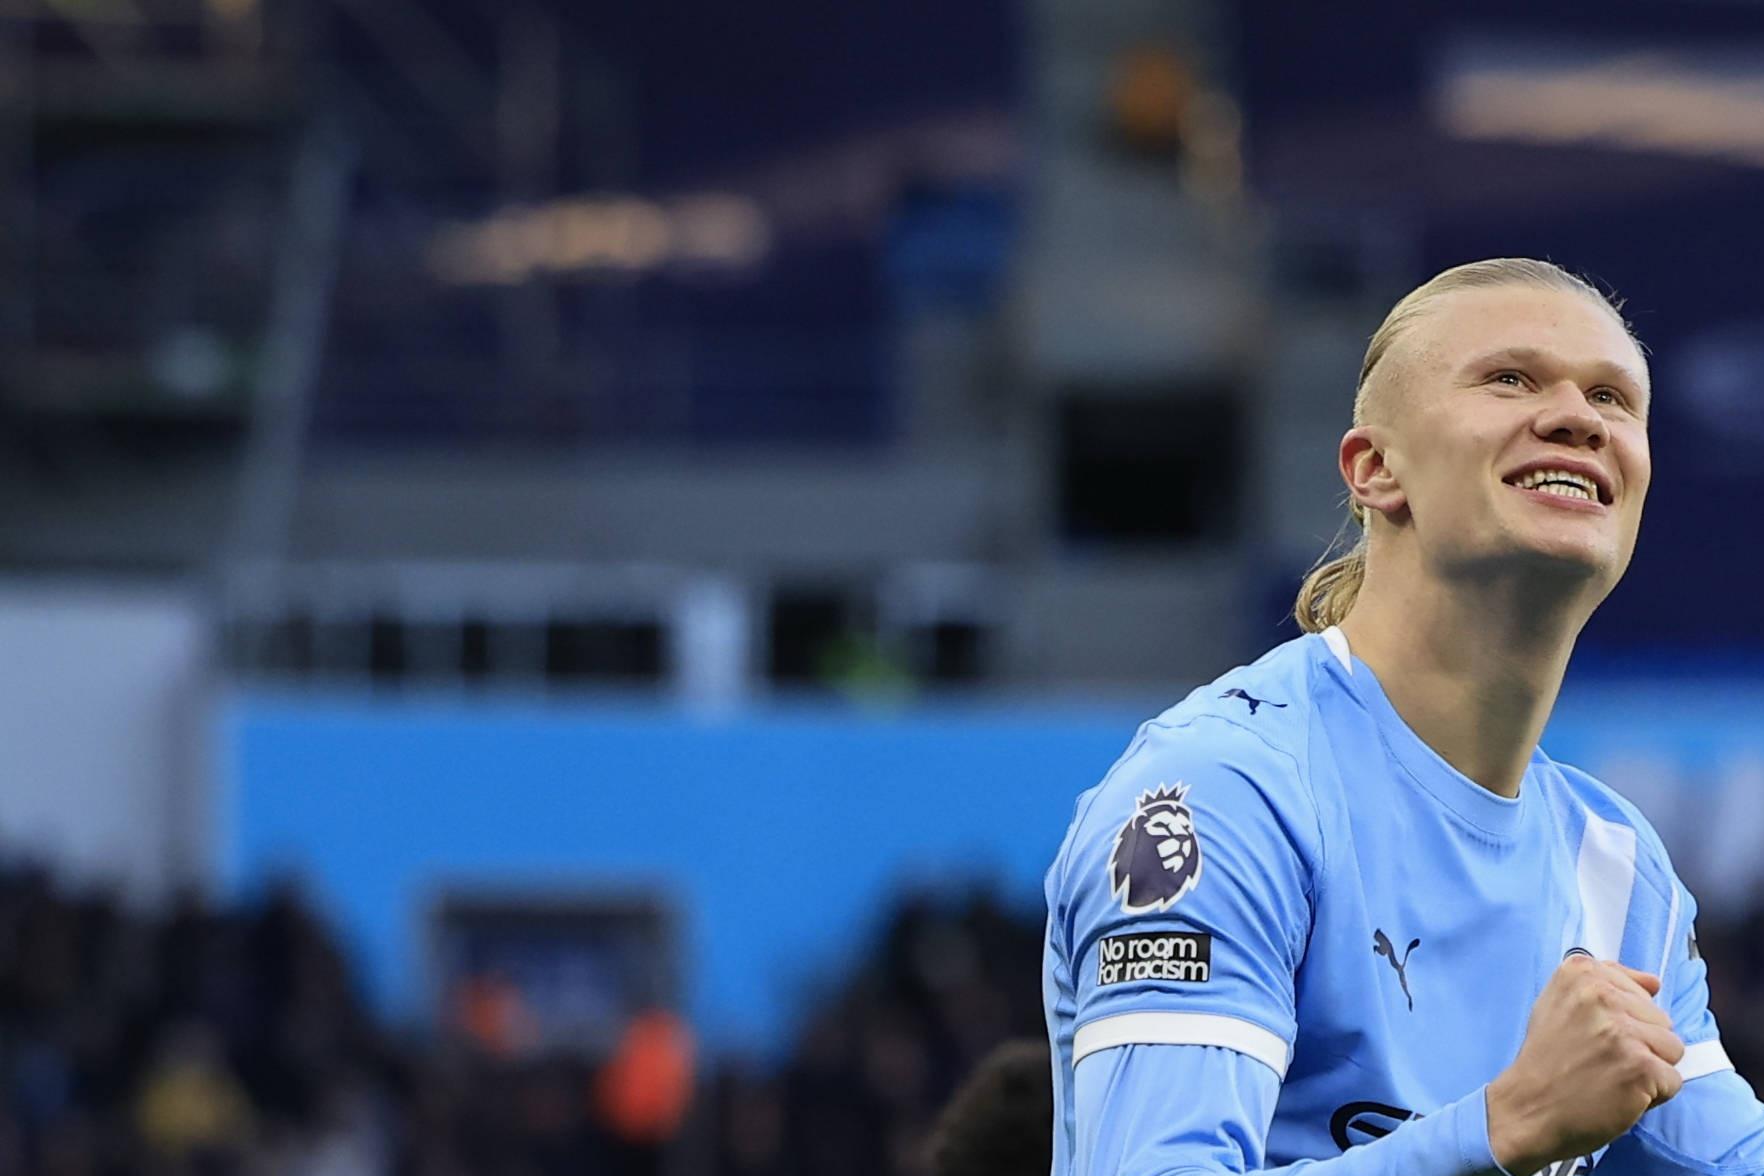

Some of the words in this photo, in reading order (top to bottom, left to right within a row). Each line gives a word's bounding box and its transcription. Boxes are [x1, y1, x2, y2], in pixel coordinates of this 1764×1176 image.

[1100, 938, 1125, 963] No
[1127, 937, 1198, 960] room
[1125, 959, 1208, 981] racism
